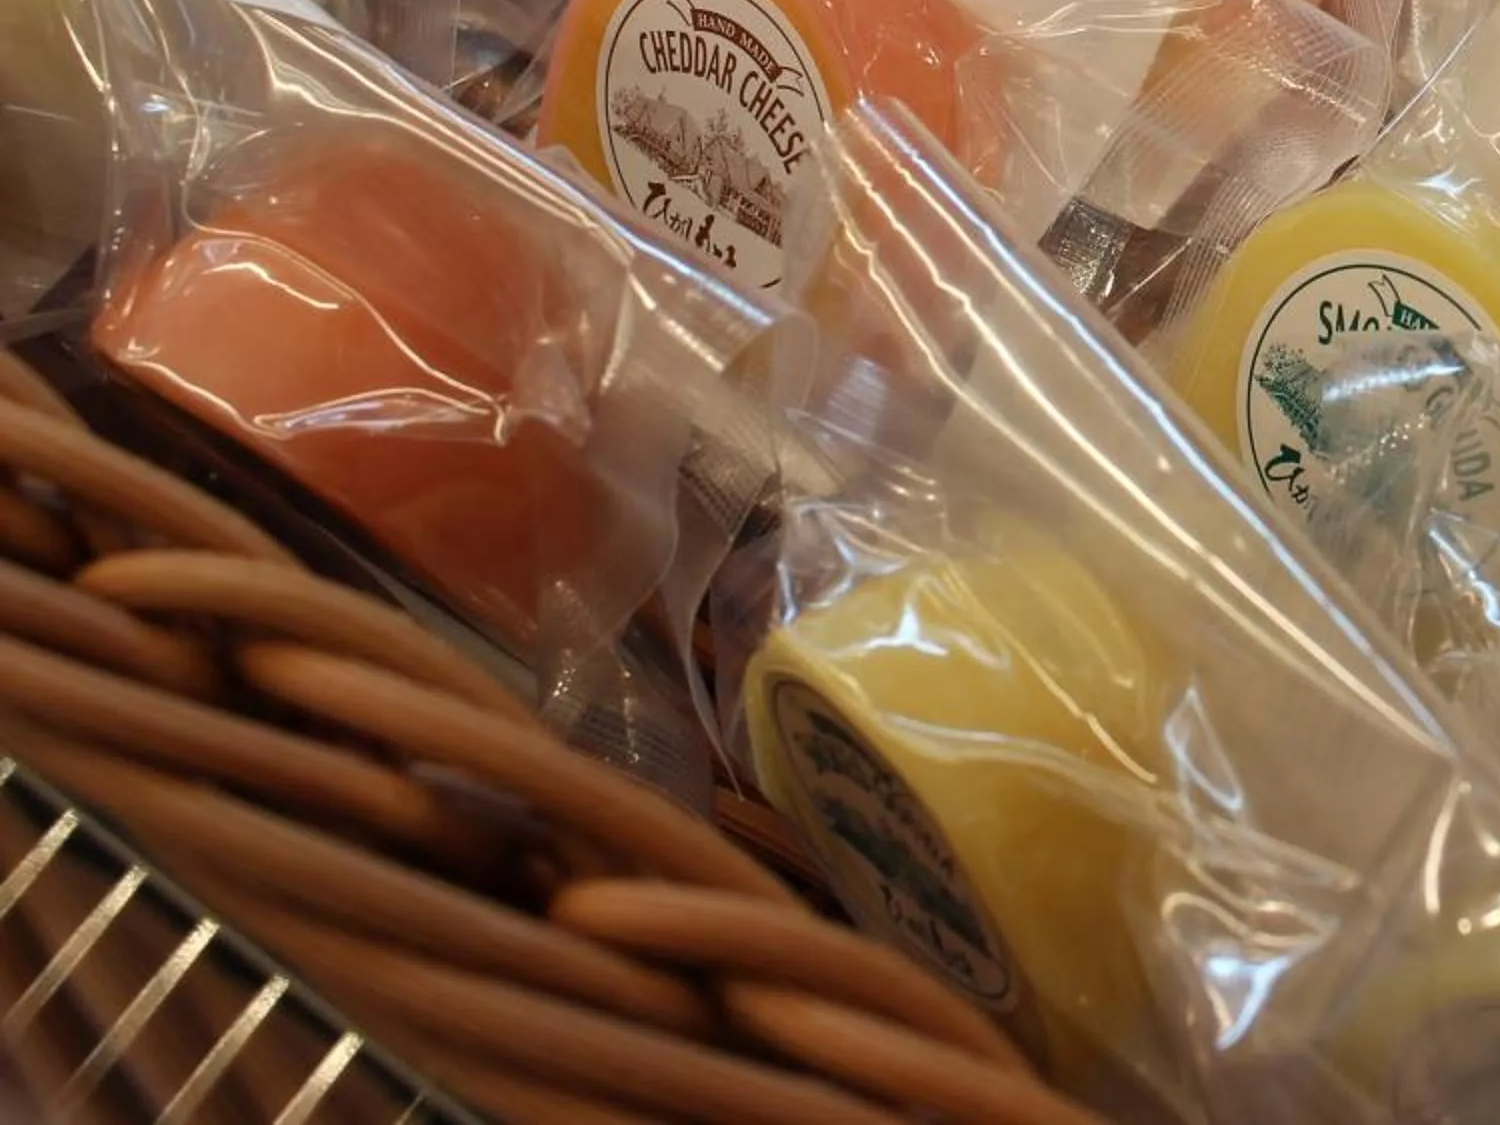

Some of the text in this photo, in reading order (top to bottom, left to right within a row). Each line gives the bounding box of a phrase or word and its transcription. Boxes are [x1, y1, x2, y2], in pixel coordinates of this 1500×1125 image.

[639, 30, 738, 95] CHEDDAR
[697, 10, 777, 76] HAND MADE
